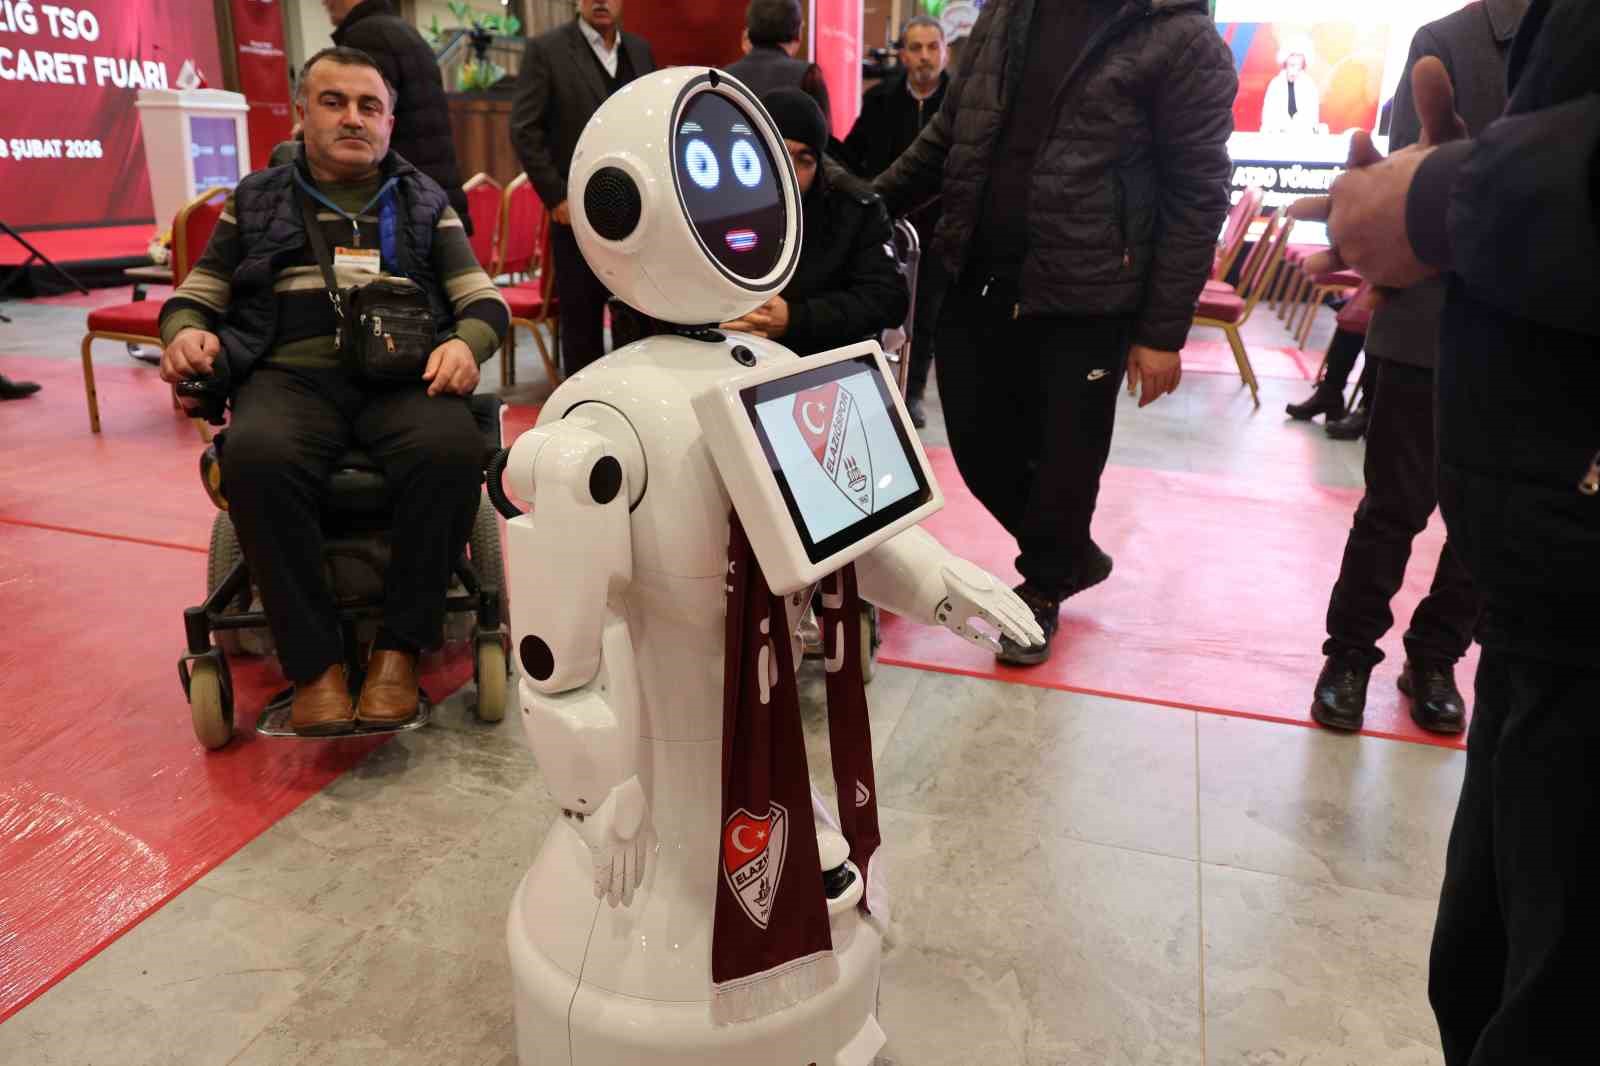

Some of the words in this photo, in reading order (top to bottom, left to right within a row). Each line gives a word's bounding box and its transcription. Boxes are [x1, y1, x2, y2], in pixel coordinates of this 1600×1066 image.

[41, 4, 100, 42] TSO
[0, 46, 88, 86] CARET
[93, 55, 168, 89] FUARI
[10, 138, 62, 161] ŞUBAT
[64, 139, 103, 159] 2026
